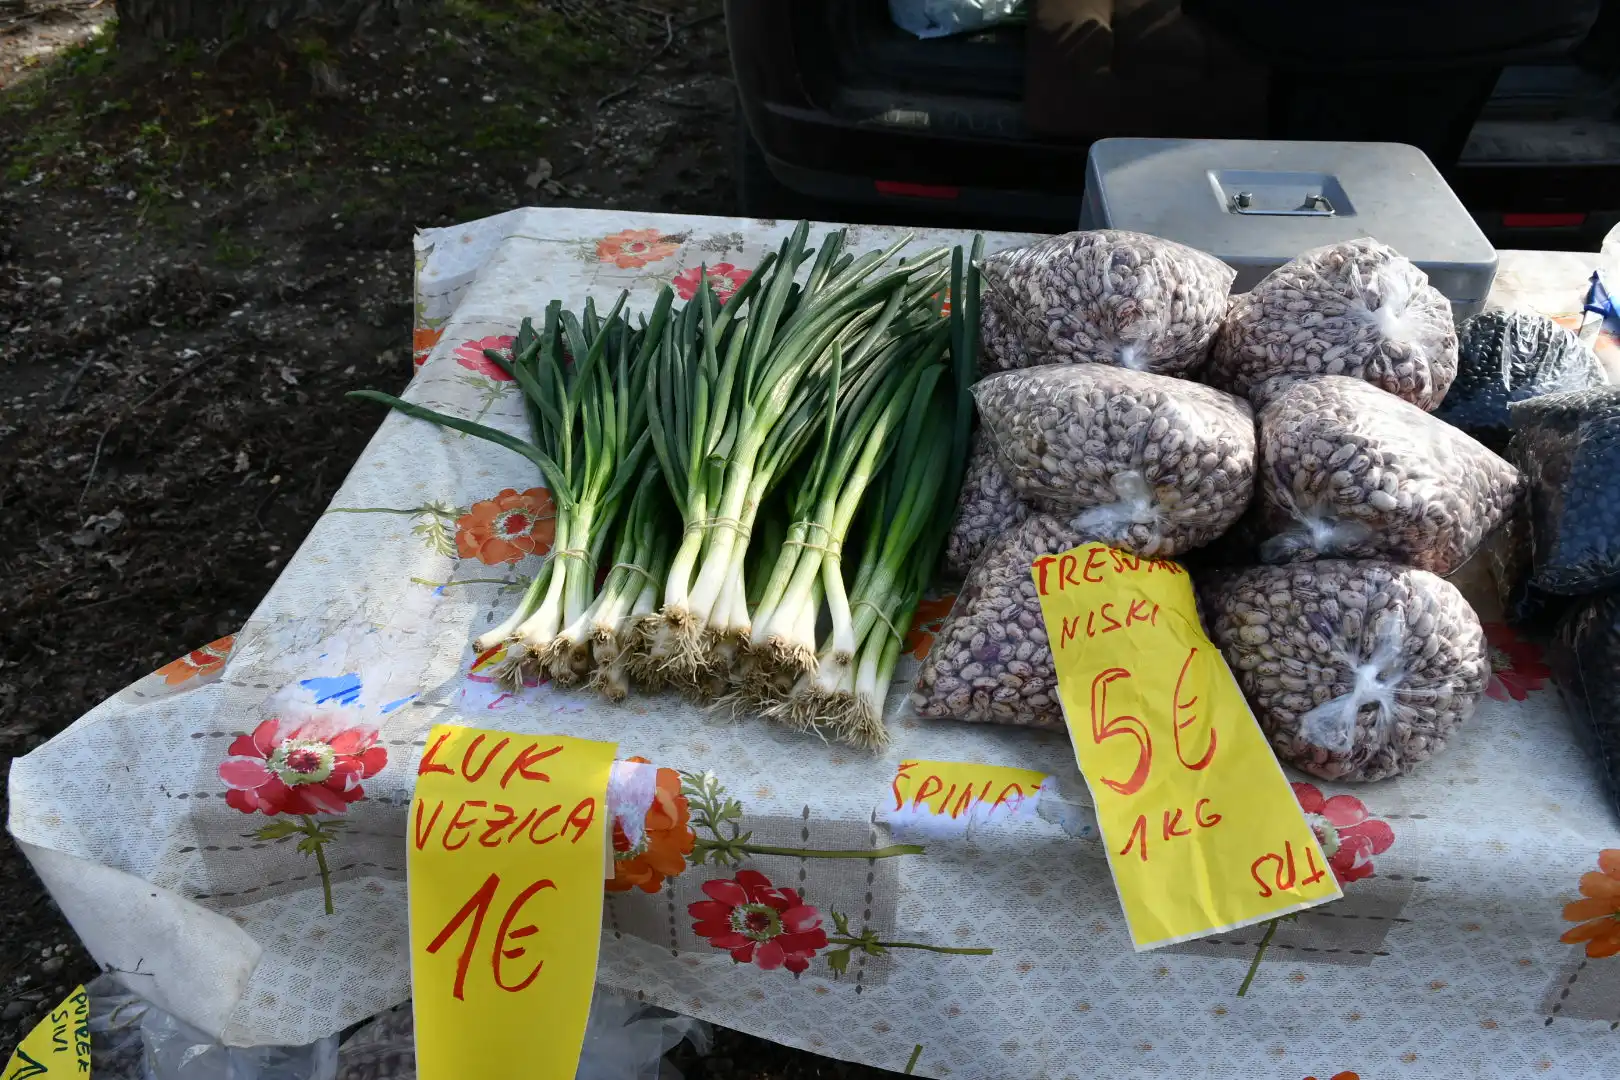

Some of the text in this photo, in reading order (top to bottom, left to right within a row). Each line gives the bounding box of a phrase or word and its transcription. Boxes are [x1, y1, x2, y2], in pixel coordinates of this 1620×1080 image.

[1061, 599, 1160, 649] NISKI
[417, 731, 564, 790] LUK
[415, 797, 596, 851] VEZICA
[1162, 798, 1222, 841] KG
[425, 872, 558, 1002] 1€
[51, 1010, 69, 1054] SIVI
